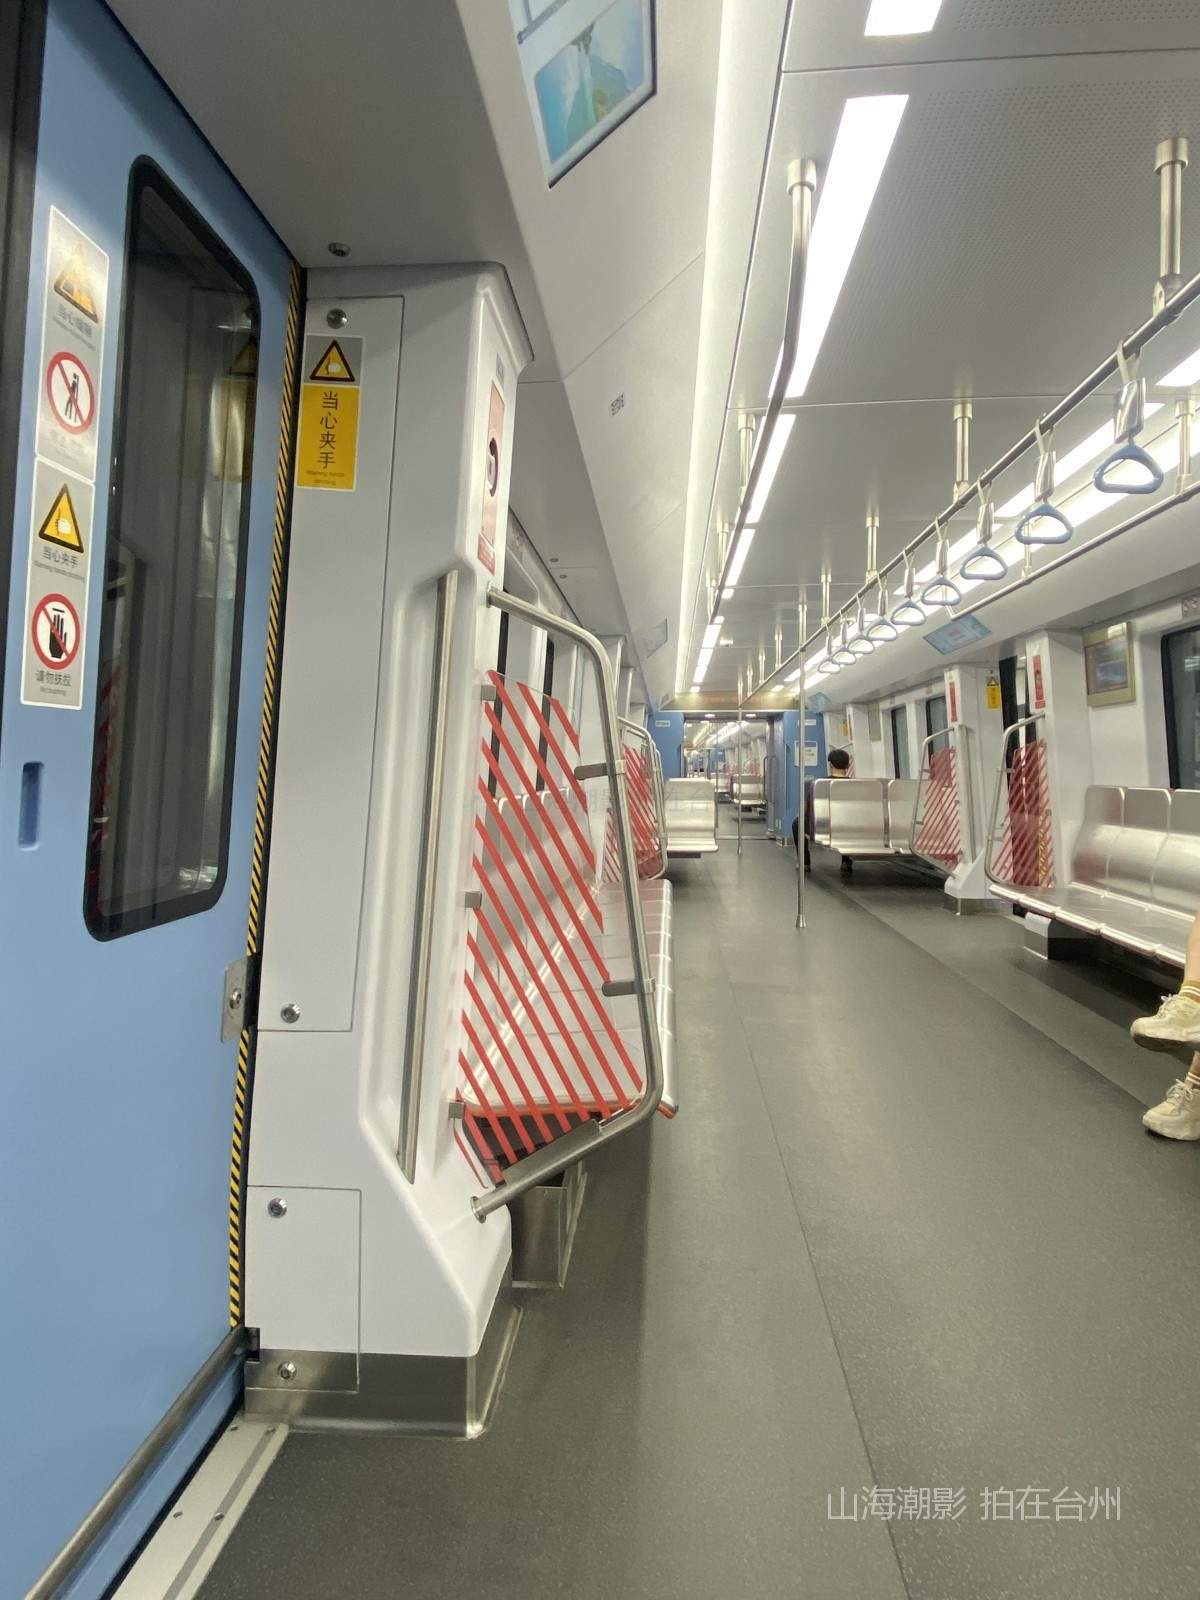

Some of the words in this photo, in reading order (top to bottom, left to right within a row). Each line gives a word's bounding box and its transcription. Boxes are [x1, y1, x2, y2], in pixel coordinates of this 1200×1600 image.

[317, 391, 339, 469] 当心夹手
[41, 546, 79, 568] 当心夹手
